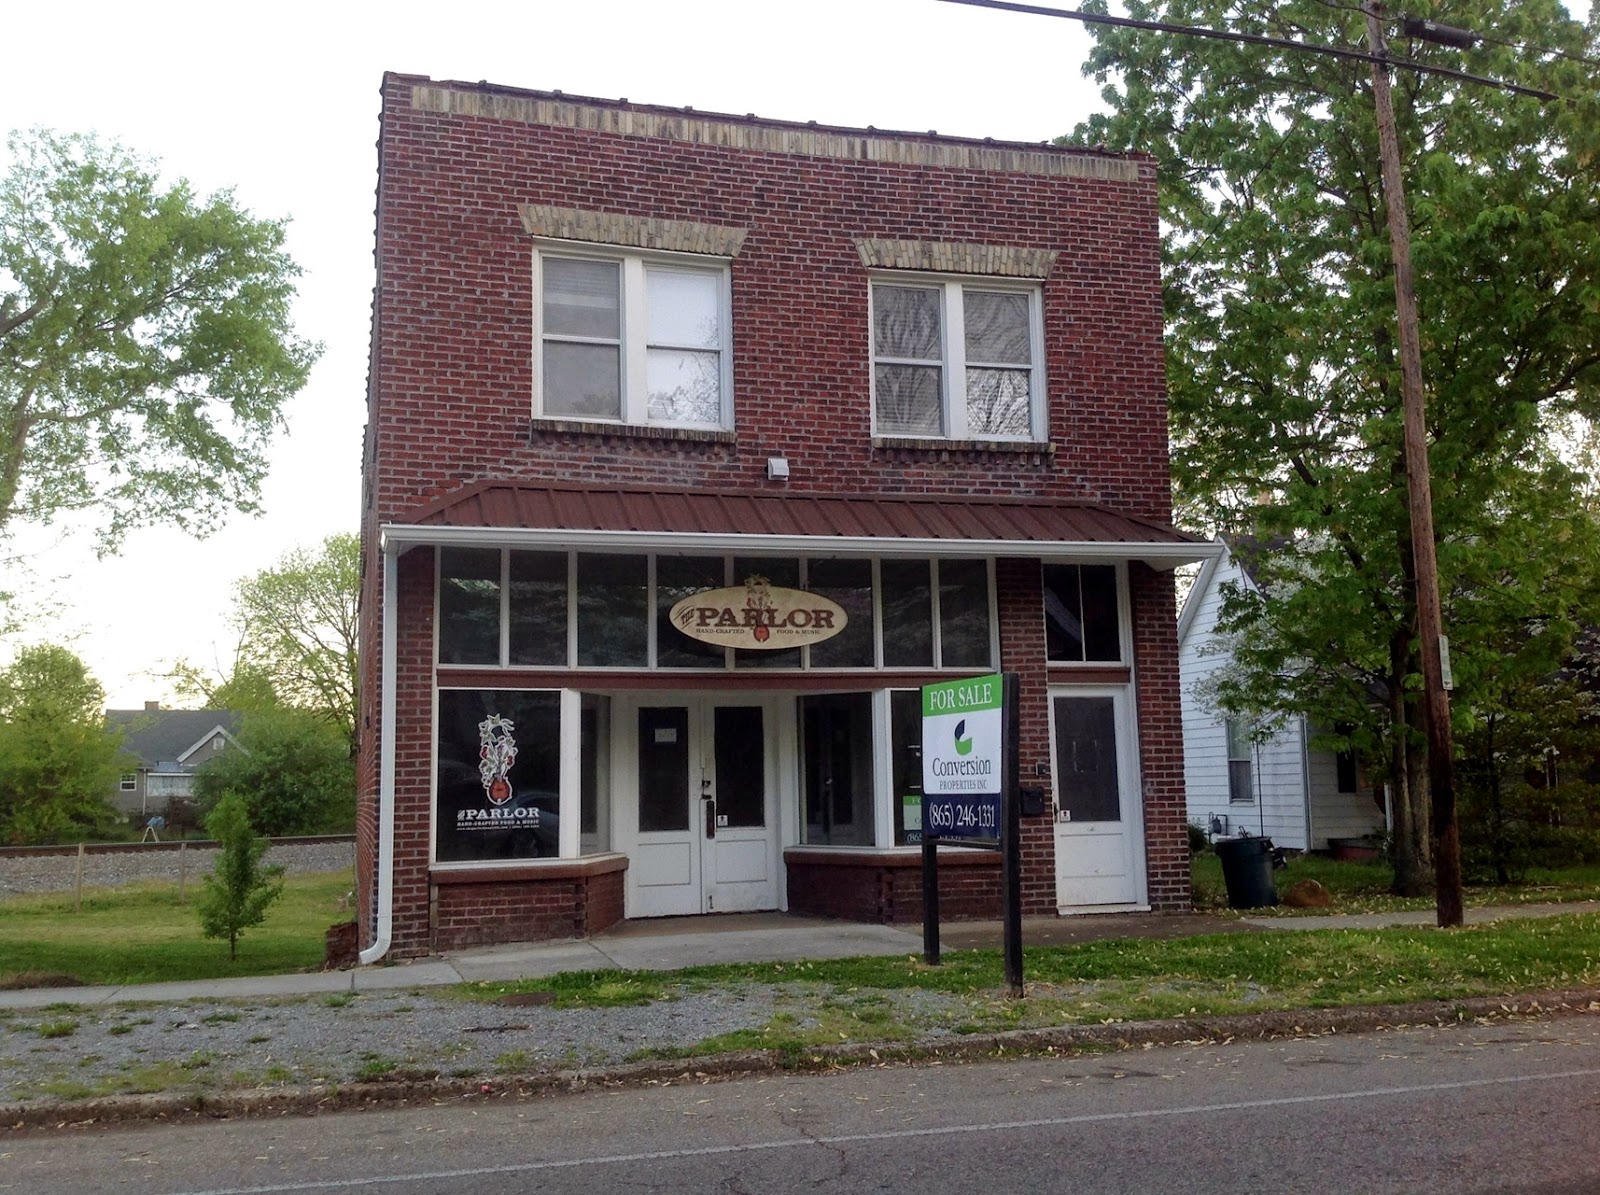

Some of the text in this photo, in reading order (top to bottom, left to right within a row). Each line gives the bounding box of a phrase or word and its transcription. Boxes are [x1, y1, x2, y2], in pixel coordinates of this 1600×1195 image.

[681, 607, 835, 629] THE PARLOR
[929, 683, 993, 711] FOR SALE
[932, 756, 992, 777] Conversion
[939, 779, 988, 790] PROPERTIES INC
[465, 807, 540, 820] PARLOR
[929, 802, 995, 830] (865) 246-1331
